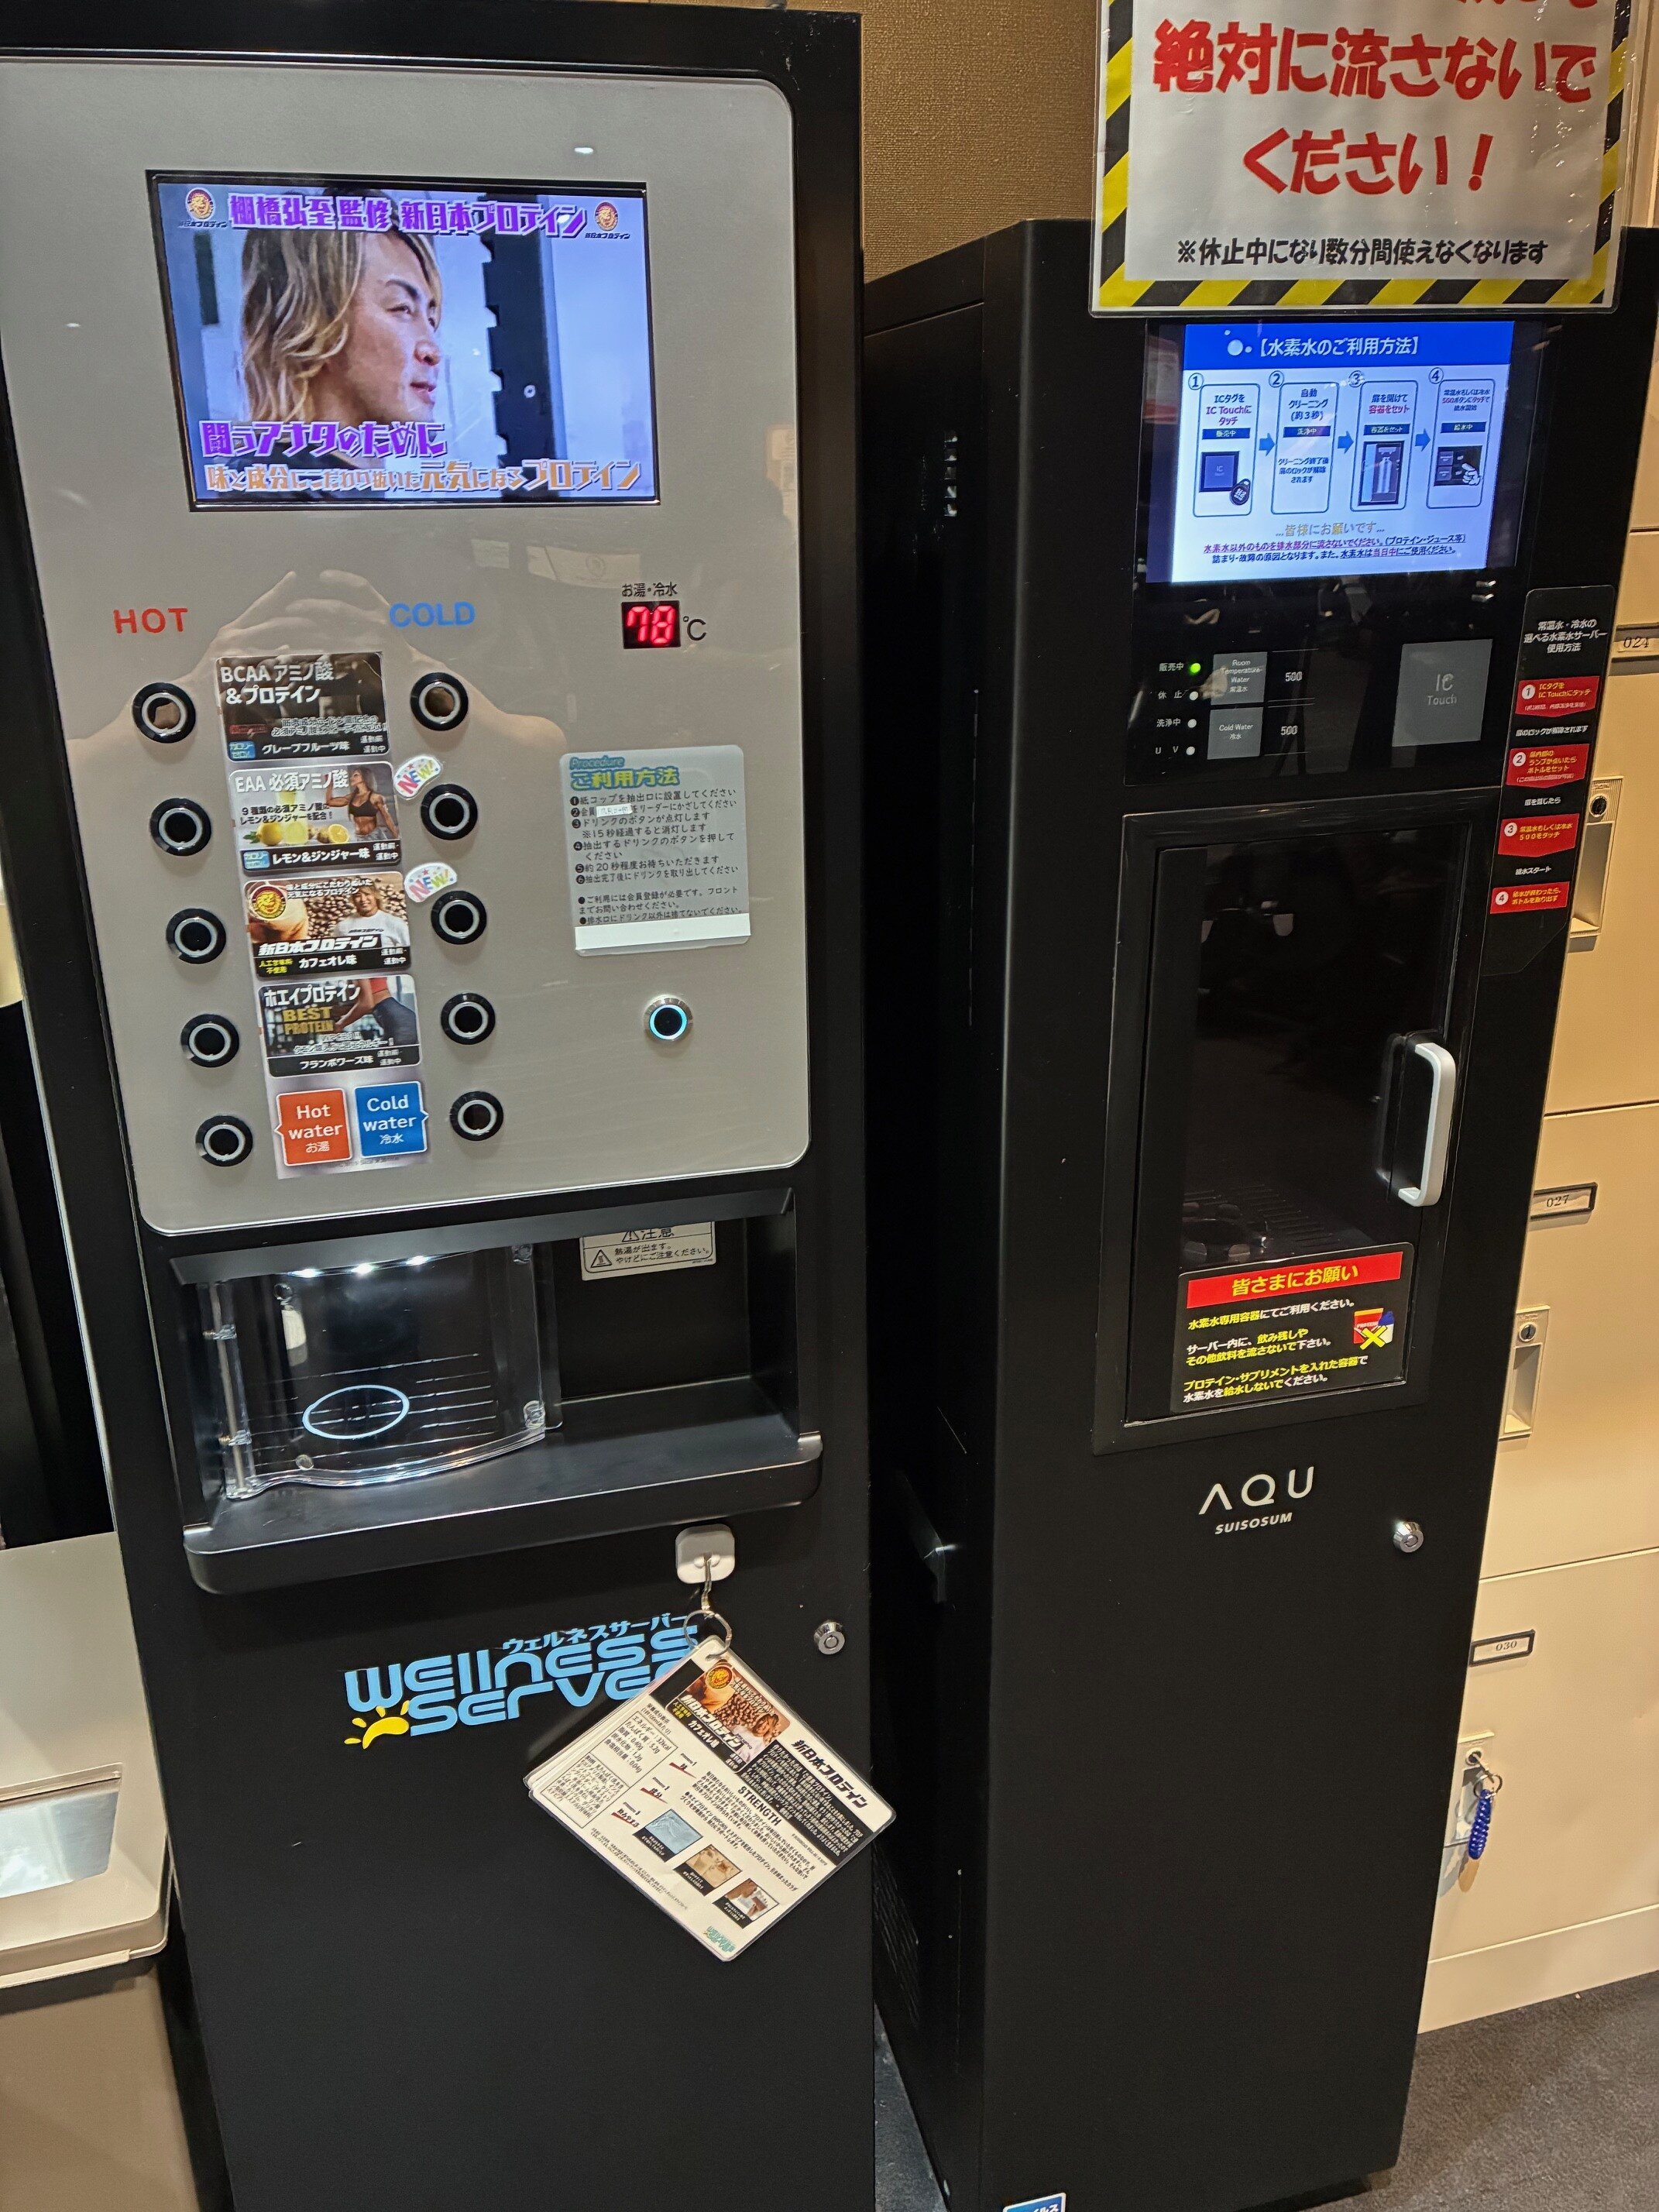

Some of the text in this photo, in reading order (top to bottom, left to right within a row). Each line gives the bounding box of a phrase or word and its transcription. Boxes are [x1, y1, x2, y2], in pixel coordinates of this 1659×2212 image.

[1152, 19, 1597, 103] 絶対に流さないで
[1244, 127, 1494, 195] ください！
[399, 198, 588, 239] 新日本プロテイン
[1177, 237, 1548, 266] ※休止中になり数分間使えなくなります
[1260, 336, 1419, 357] 【水素水のご利用方法】
[1214, 393, 1245, 404] ICタグを
[1288, 398, 1329, 409] クリーニング
[1369, 404, 1410, 414] 容器をセット
[1218, 416, 1238, 426] タッチ
[199, 421, 447, 458] 闘うアナタのために
[622, 581, 678, 598] お湯・冷水
[112, 607, 188, 634] HOT
[389, 601, 476, 629] COLD
[626, 604, 677, 646] 78
[1537, 619, 1597, 630] 常温水・冷水の
[1523, 629, 1608, 644] 選べる水素水サーバー
[1546, 642, 1582, 654] 使用方法
[220, 661, 335, 683] BCAA アミノ酸
[1159, 661, 1184, 672] 販売中
[1285, 671, 1303, 682] 500
[1434, 673, 1455, 691] IC
[1426, 694, 1458, 706] Touch
[1156, 717, 1181, 728] 洗浄中
[1280, 725, 1298, 736] 500
[262, 740, 351, 755] グレープフルーツ味
[235, 769, 349, 792] EAA 必須アミノ酸
[570, 766, 680, 791] ご利用方法
[585, 850, 623, 861] ください
[259, 935, 379, 957] 新日本プロテイン
[298, 955, 358, 970] カフェオレ味
[263, 984, 361, 1008] ホエイプロテイン
[282, 1006, 333, 1023] BEST
[283, 1020, 335, 1035] PROTEIN
[366, 1094, 410, 1112] Cold
[296, 1104, 331, 1120] Hot
[288, 1124, 343, 1140] water
[362, 1116, 417, 1132] water
[305, 1140, 331, 1153] お湯
[379, 1133, 404, 1145] 冷水
[1545, 1194, 1571, 1207] 027
[1231, 1265, 1358, 1297] 皆さまにお願い
[1187, 1298, 1355, 1331] 水素水専用容器にてご利用ください。
[1185, 1337, 1332, 1367] その他飲料を流さないで下さい。
[1183, 1356, 1369, 1392] プロテイン・サプリメントを入れた容器で
[1183, 1375, 1328, 1403] 水素水を給水しないでください。
[1214, 1512, 1293, 1535] SUISOSUM
[502, 1612, 689, 1655] ウェルネスサーバー
[1495, 1639, 1518, 1652] 030
[791, 1736, 869, 1811] 新日本プロテイン
[736, 1784, 782, 1826] STRENGTH
